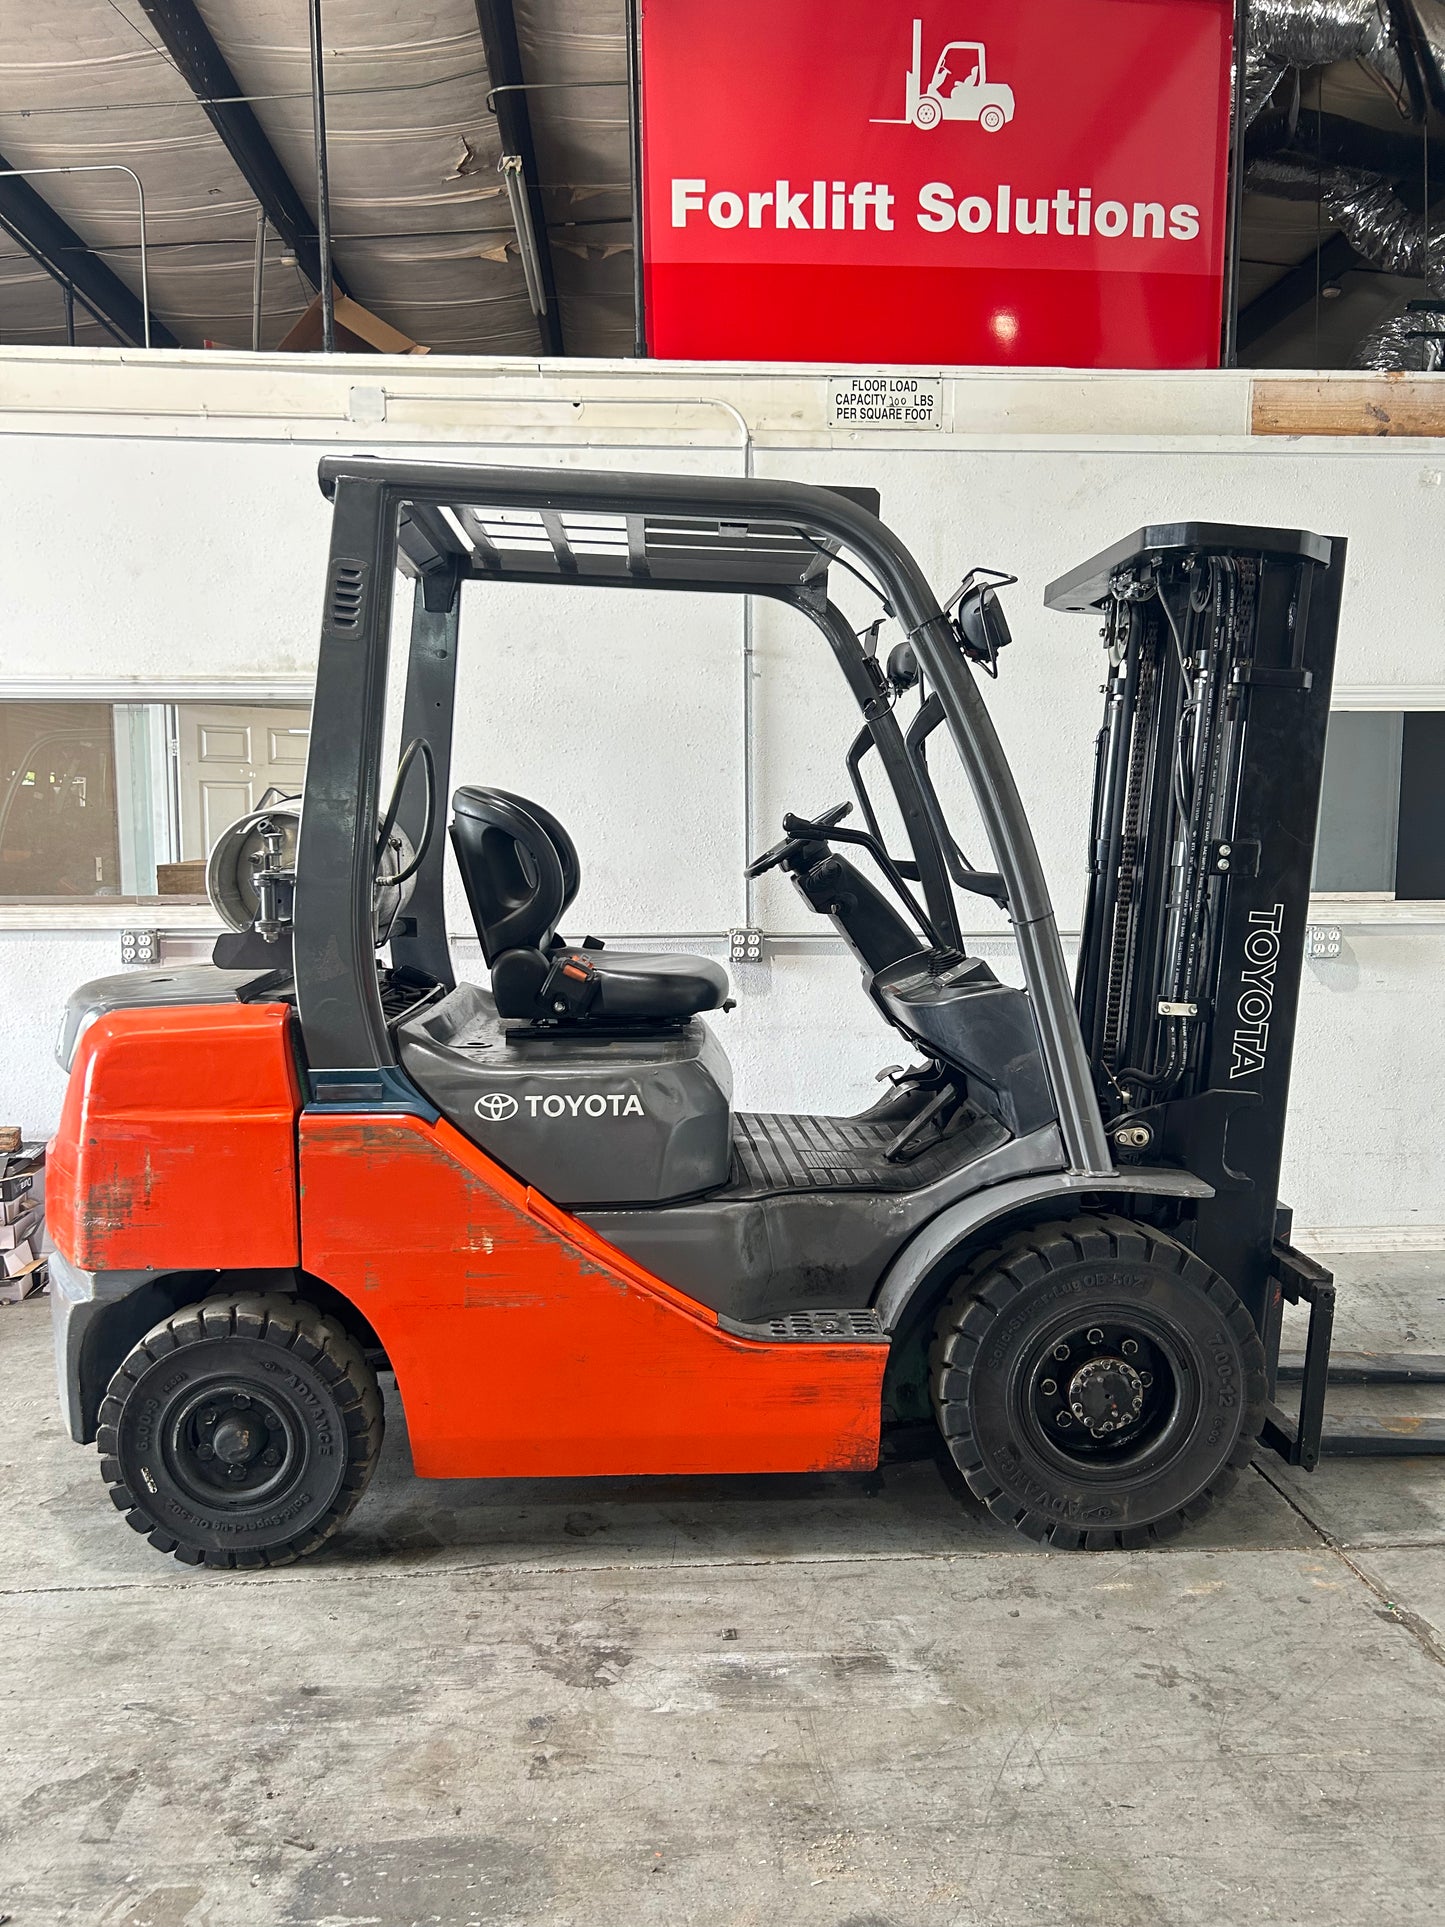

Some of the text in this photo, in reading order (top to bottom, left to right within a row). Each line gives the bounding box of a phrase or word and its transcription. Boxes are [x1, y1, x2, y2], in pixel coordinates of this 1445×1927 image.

[671, 178, 1200, 241] Forklift Solutions
[852, 380, 918, 392] FLOOR LOAD
[835, 393, 887, 406] CAPACITY
[914, 394, 934, 407] LBS
[836, 407, 933, 421] PER SQUARE FOOT
[1229, 903, 1285, 1080] TOYOTA
[524, 1094, 645, 1117] TOYOTA
[284, 1373, 334, 1456] ADVANCE
